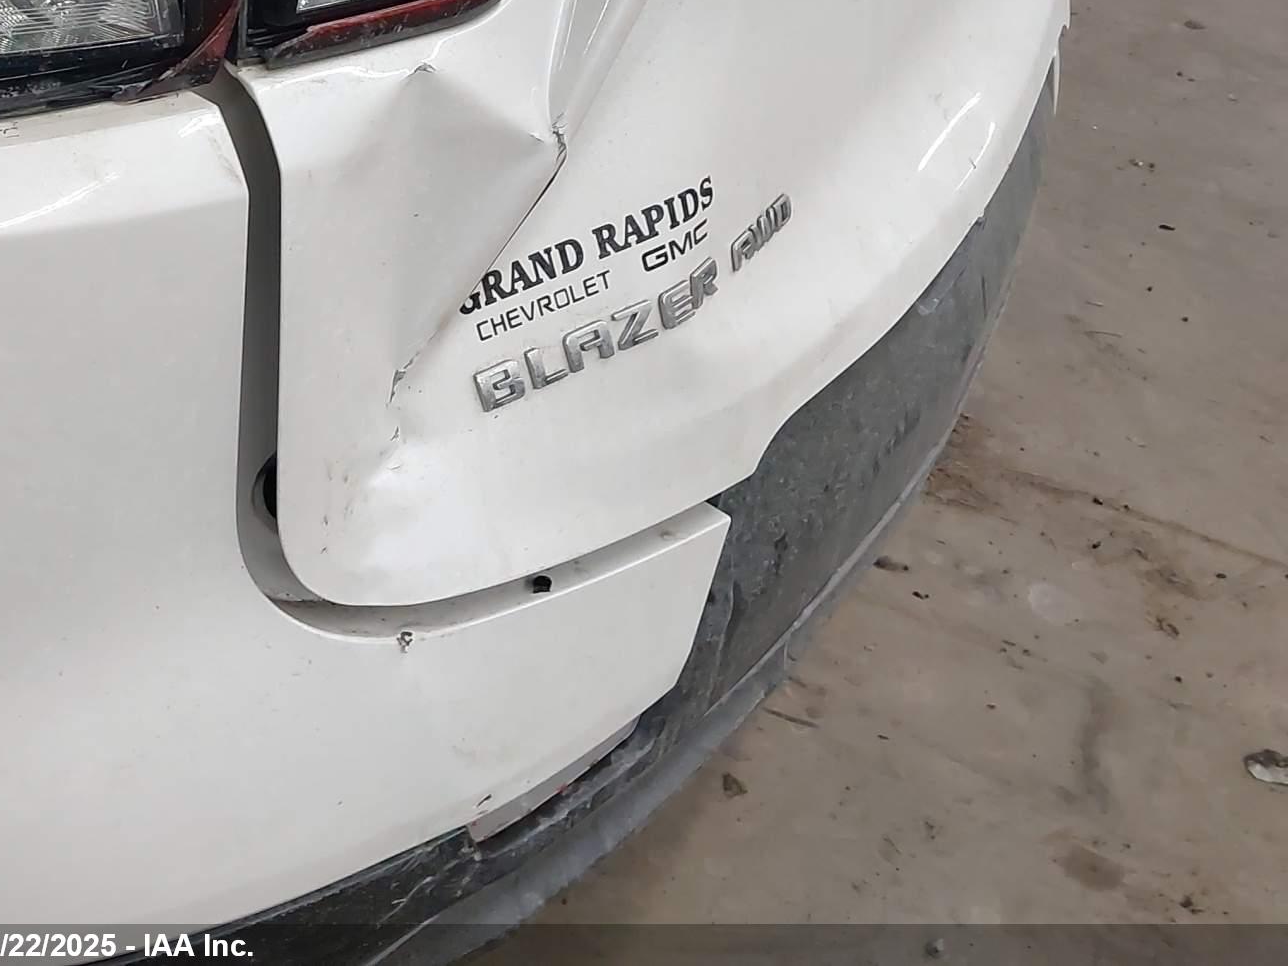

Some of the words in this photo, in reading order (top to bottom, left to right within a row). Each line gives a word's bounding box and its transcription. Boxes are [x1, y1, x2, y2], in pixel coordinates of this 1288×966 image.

[591, 175, 714, 260] RAPIDS
[472, 256, 719, 412] BLAZER
[730, 193, 792, 273] AWD
[475, 269, 611, 341] CHEVROLET
[641, 218, 709, 272] GMC
